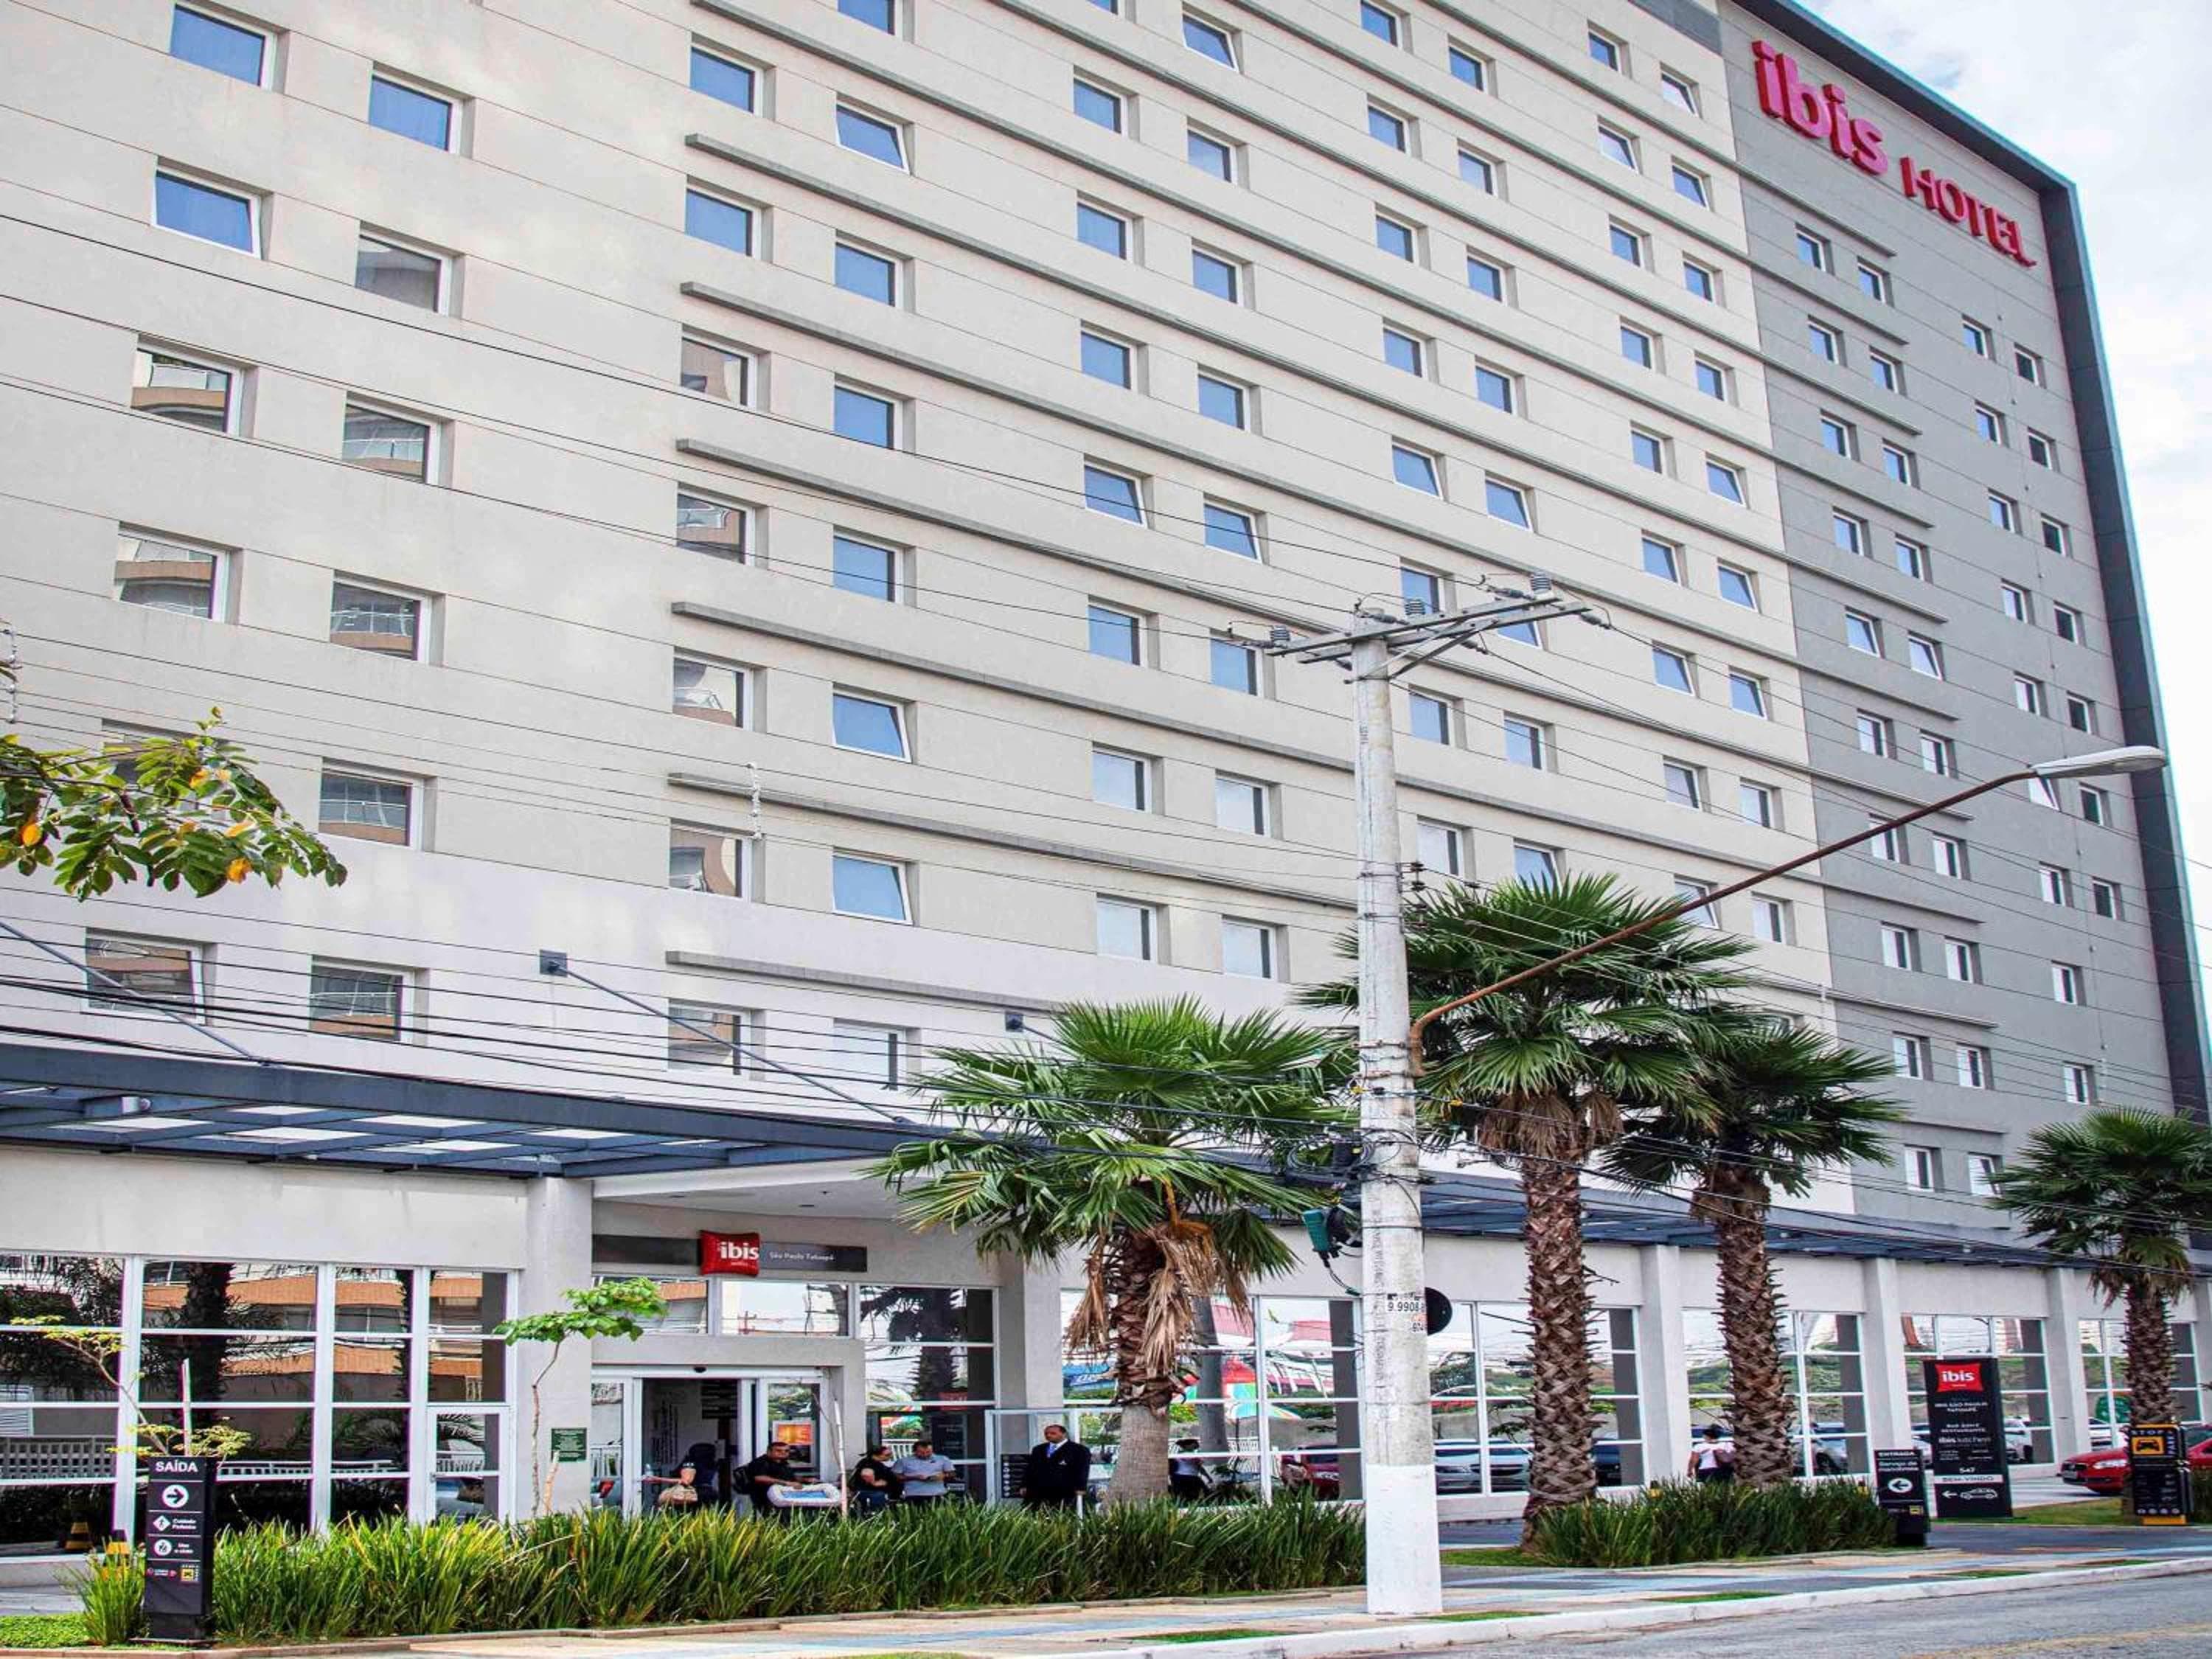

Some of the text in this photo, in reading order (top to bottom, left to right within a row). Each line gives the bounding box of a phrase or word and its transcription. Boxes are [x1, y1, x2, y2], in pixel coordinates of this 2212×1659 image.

[1752, 40, 2037, 268] ibis HOTEL
[720, 1242, 759, 1260] ibis
[1941, 1371, 1975, 1382] ibis
[155, 1459, 198, 1473] SAÍDA
